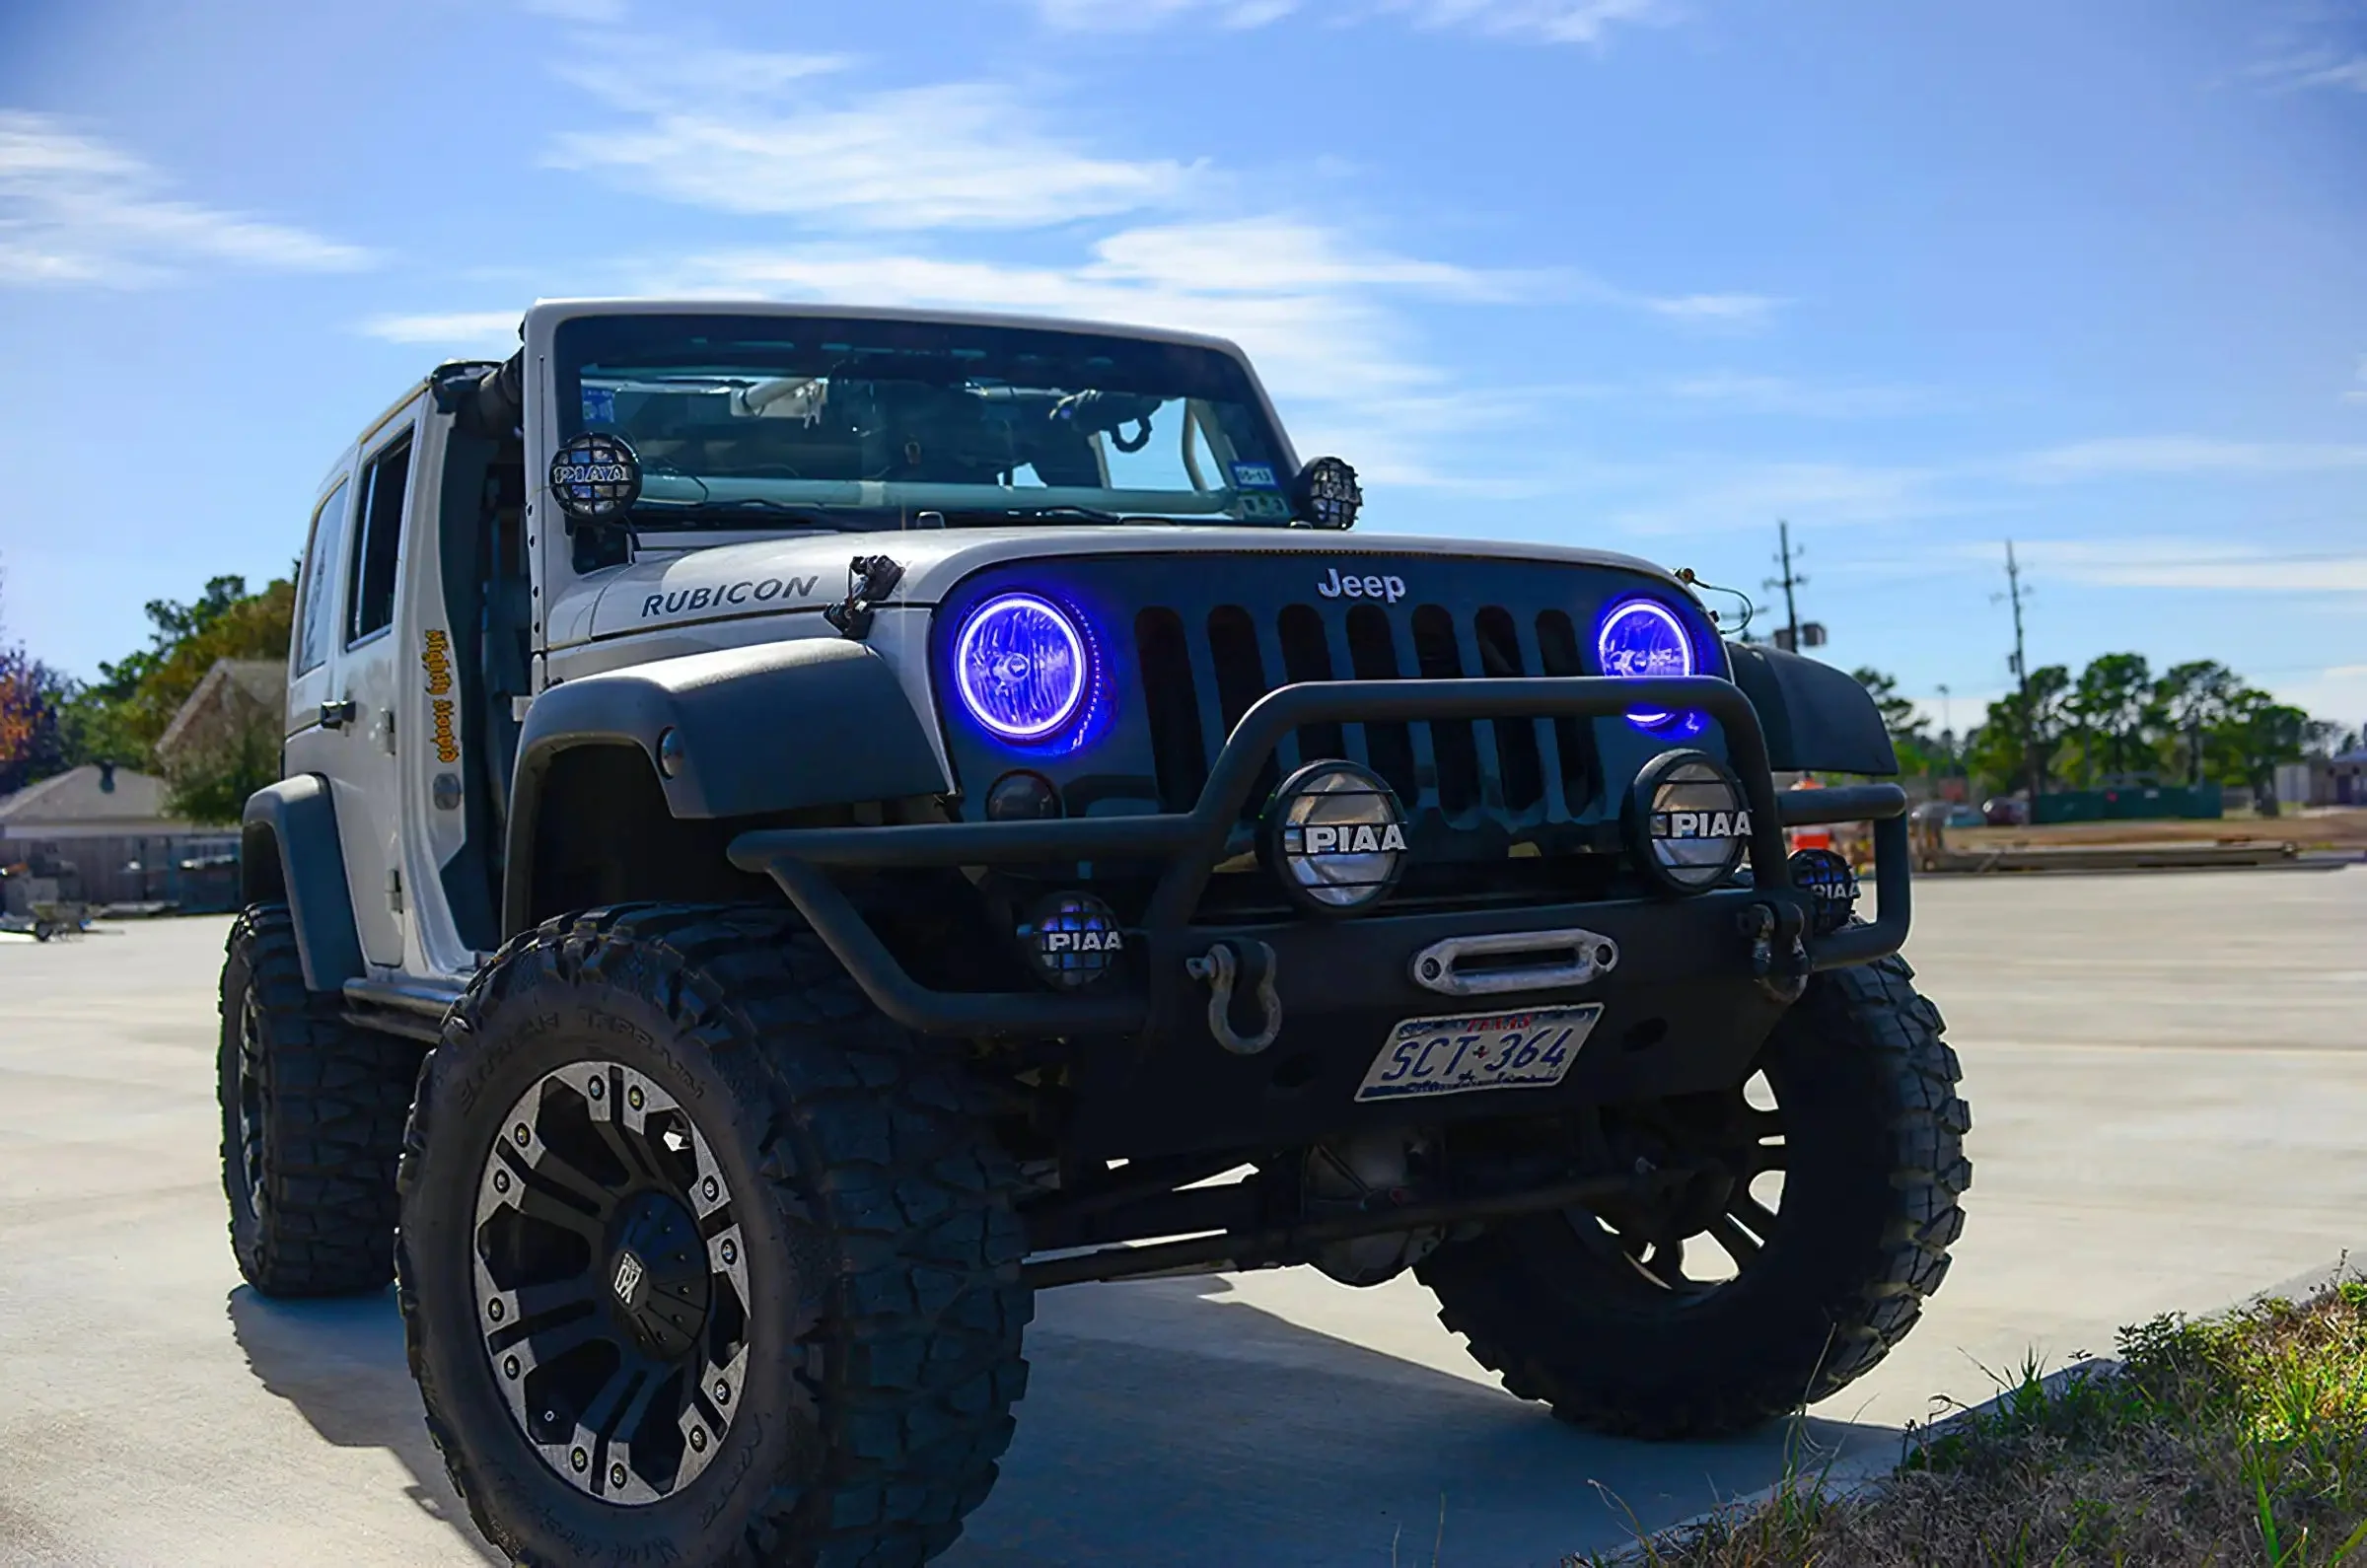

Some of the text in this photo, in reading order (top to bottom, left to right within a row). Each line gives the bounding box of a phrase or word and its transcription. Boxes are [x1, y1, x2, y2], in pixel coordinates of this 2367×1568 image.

[553, 464, 630, 484] PIAA
[641, 575, 819, 617] RUBICON
[1318, 567, 1406, 604] Jeep
[1304, 823, 1408, 854] PIAA
[1671, 811, 1754, 838] PIAA
[1045, 931, 1122, 953] PIAA
